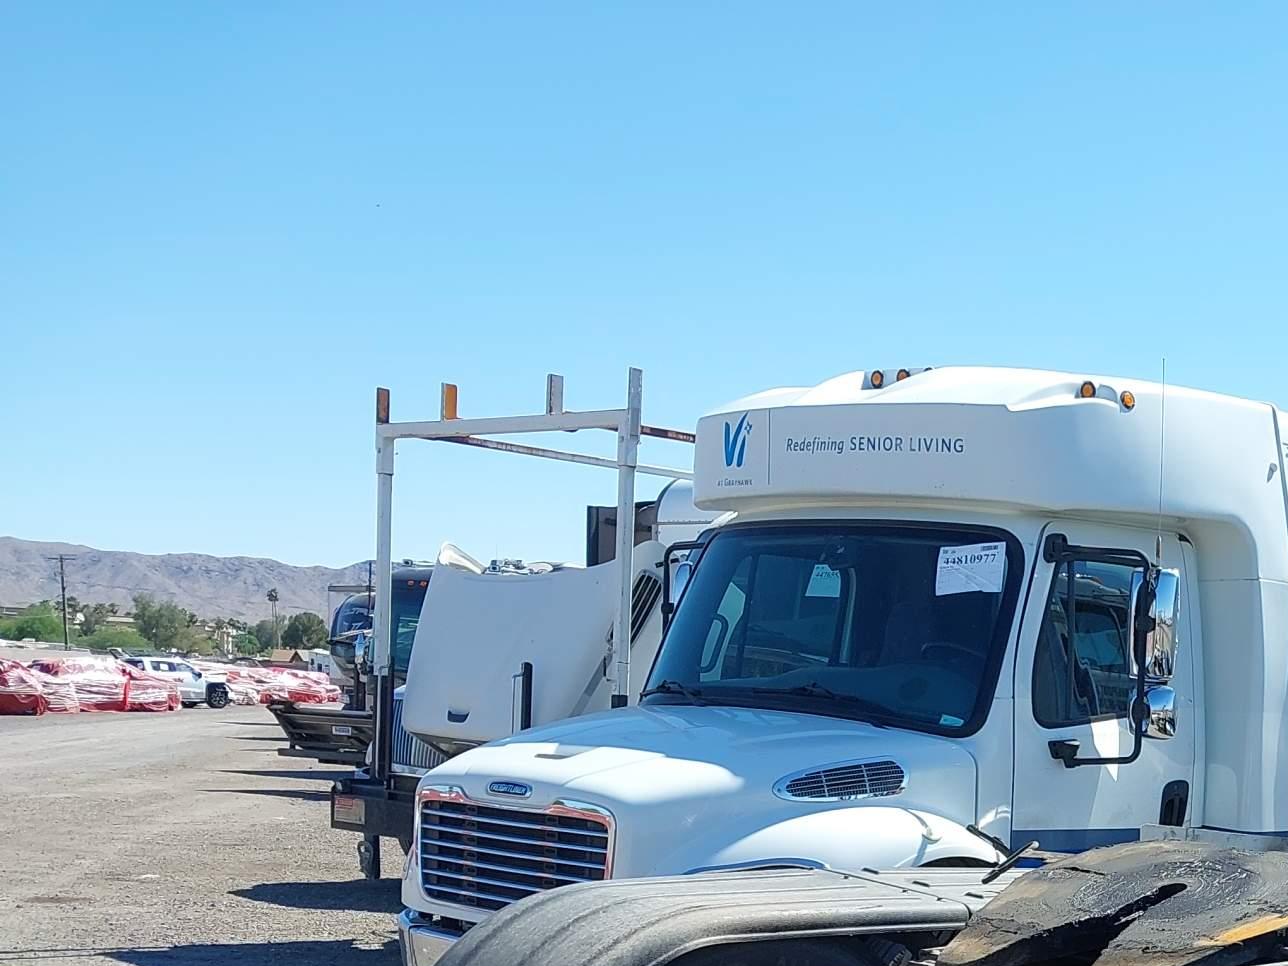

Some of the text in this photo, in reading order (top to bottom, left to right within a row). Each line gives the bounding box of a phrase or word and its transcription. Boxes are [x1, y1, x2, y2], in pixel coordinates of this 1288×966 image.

[786, 436, 964, 454] Redefining SENIOR LIVING
[943, 553, 996, 565] 44810977
